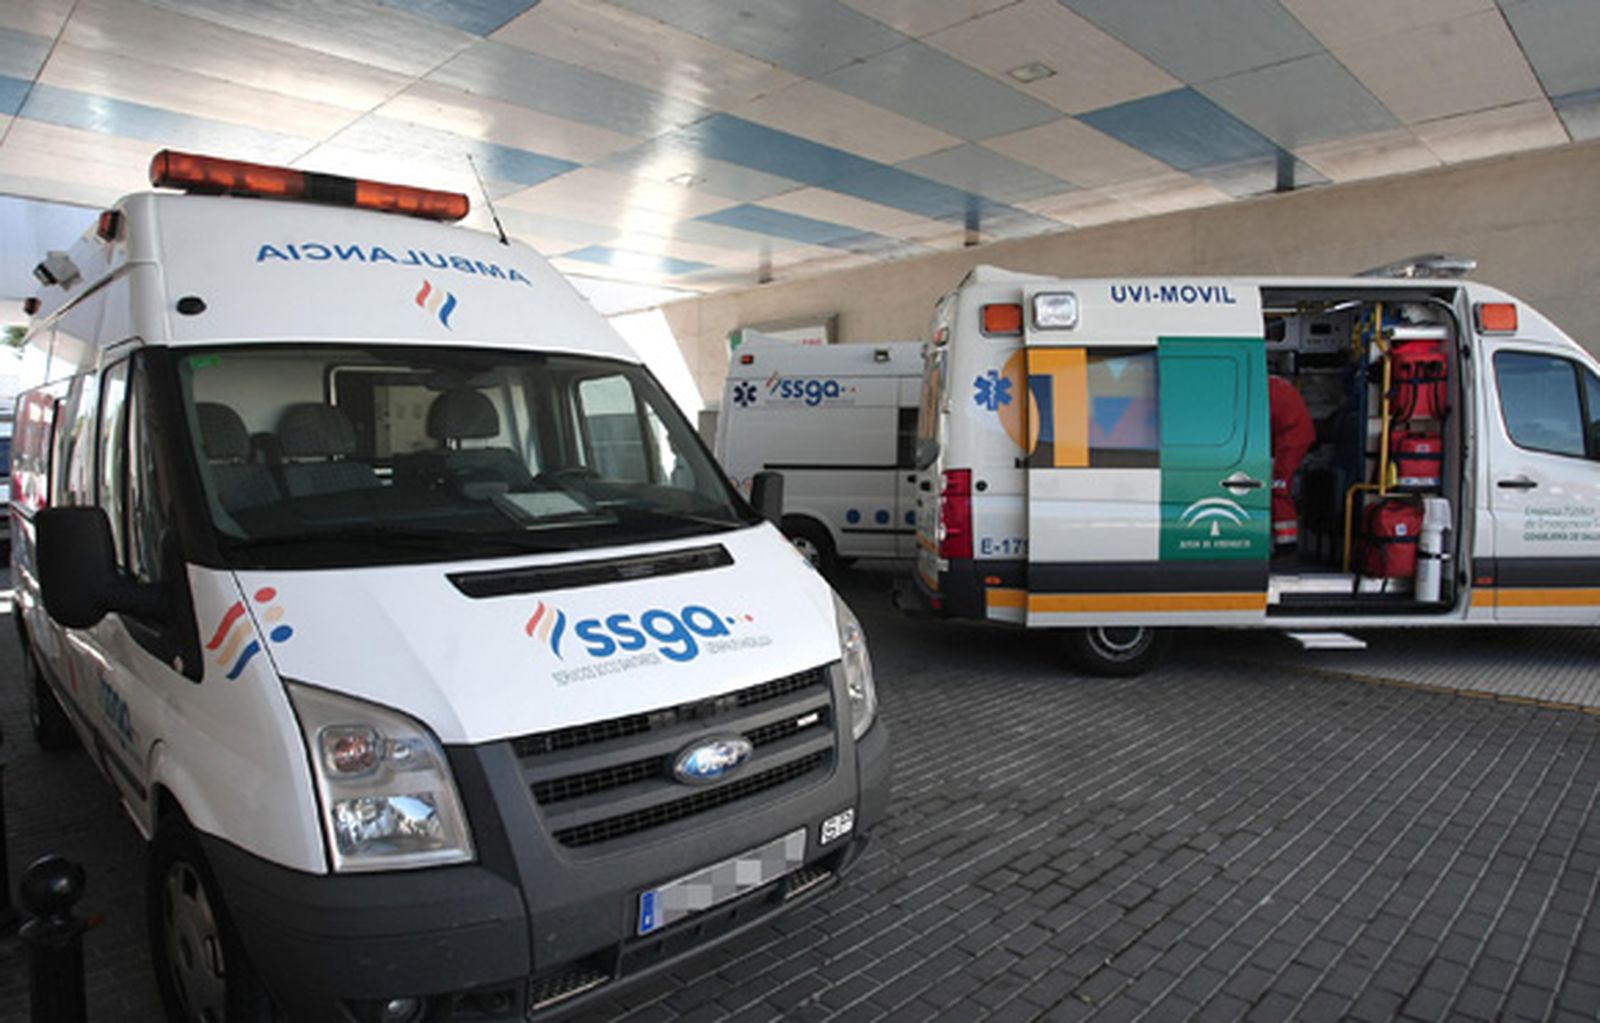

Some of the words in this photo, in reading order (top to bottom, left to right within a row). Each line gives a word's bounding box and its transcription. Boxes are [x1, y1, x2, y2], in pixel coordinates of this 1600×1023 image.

[1110, 285, 1237, 303] UVI-MOVIL
[780, 379, 840, 406] ssga
[574, 605, 730, 661] ssga
